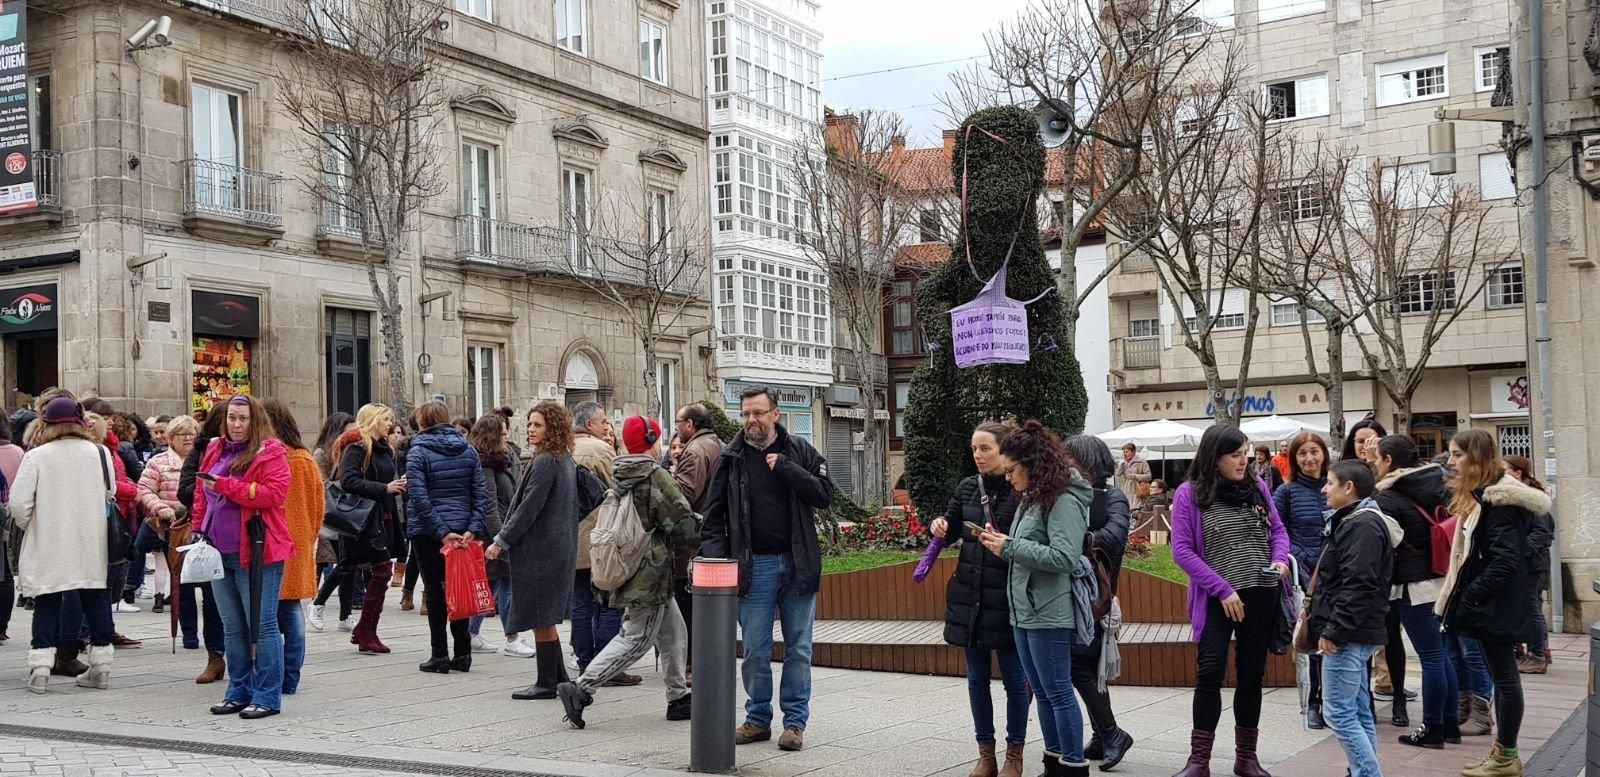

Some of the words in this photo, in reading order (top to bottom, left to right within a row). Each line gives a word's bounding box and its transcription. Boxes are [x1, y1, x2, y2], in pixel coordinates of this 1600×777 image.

[13, 73, 26, 82] para
[776, 388, 806, 403] Cumbre
[1299, 393, 1329, 404] BA
[479, 598, 490, 607] KO
